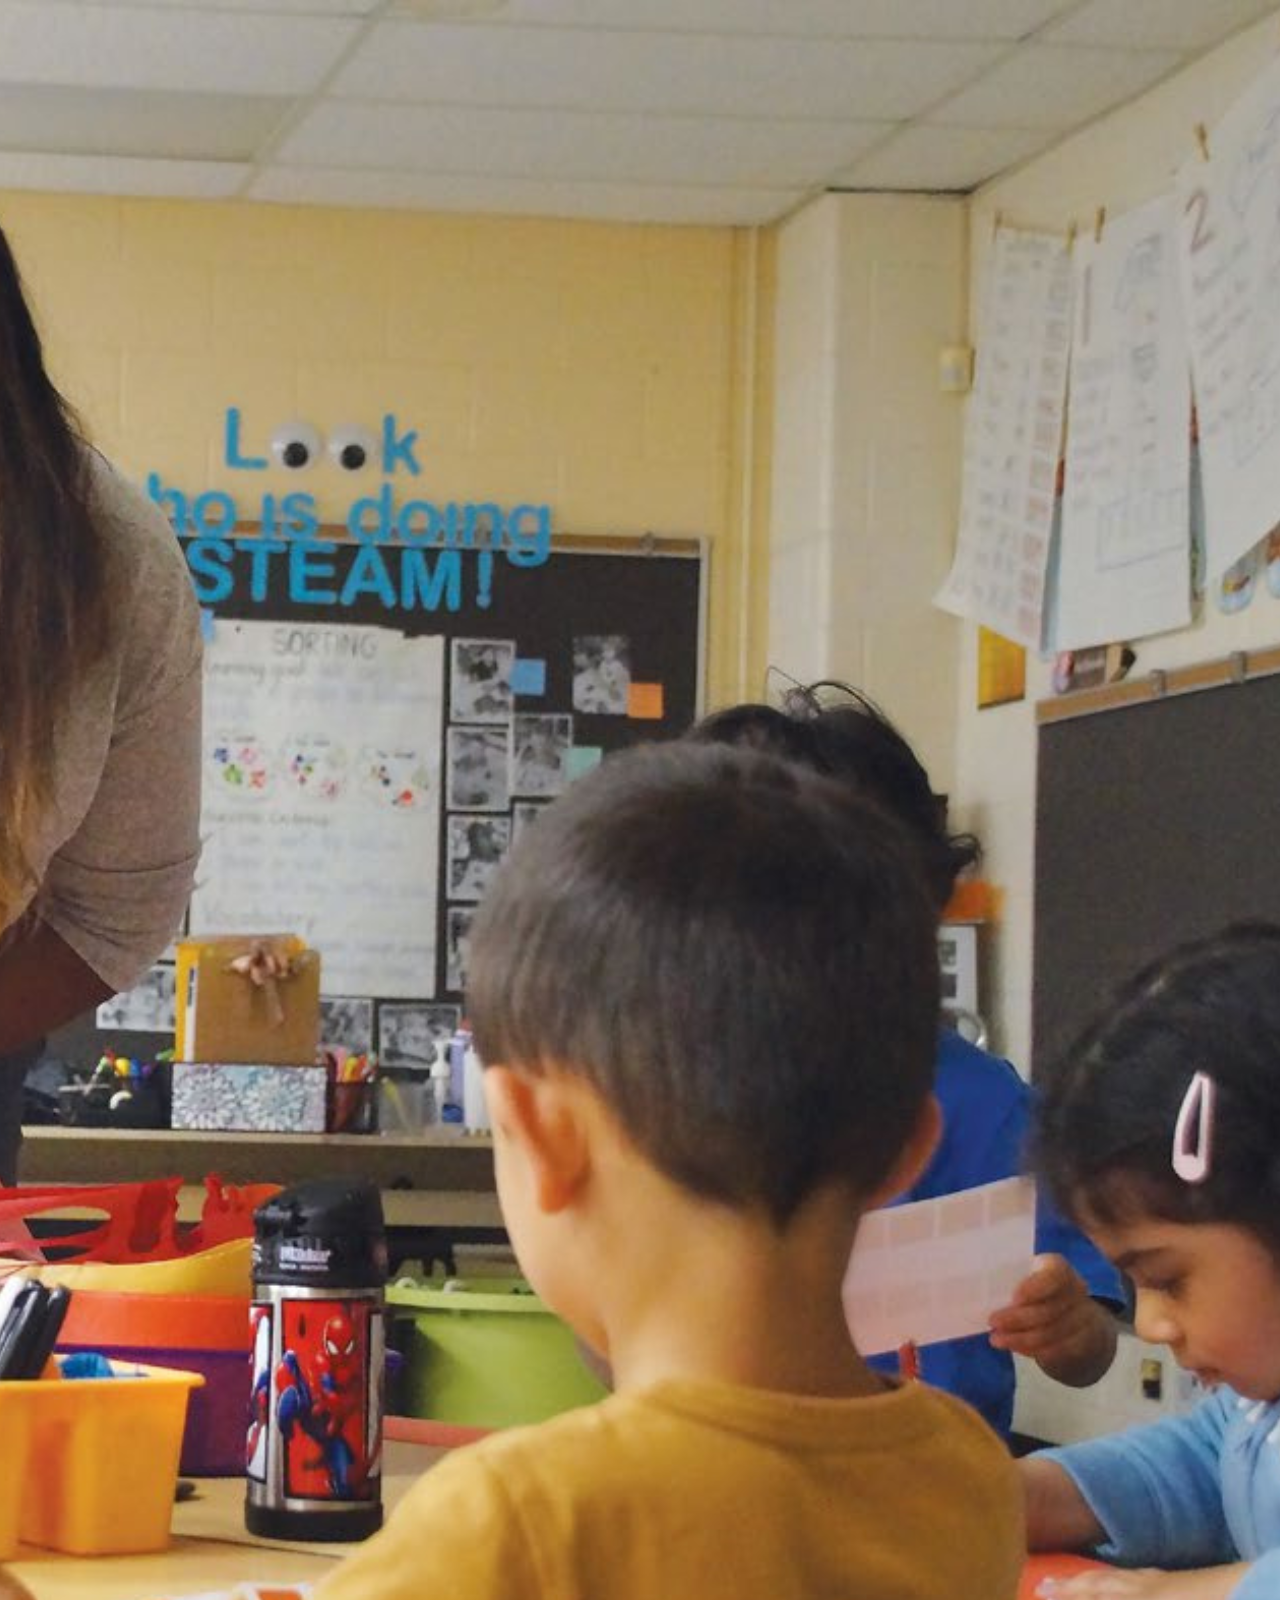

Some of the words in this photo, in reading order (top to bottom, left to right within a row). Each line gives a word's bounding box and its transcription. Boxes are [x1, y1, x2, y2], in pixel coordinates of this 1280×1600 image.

[262, 492, 318, 541] is
[346, 483, 552, 568] doing
[185, 537, 493, 612] STEAM!
[272, 628, 379, 660] SORTING
